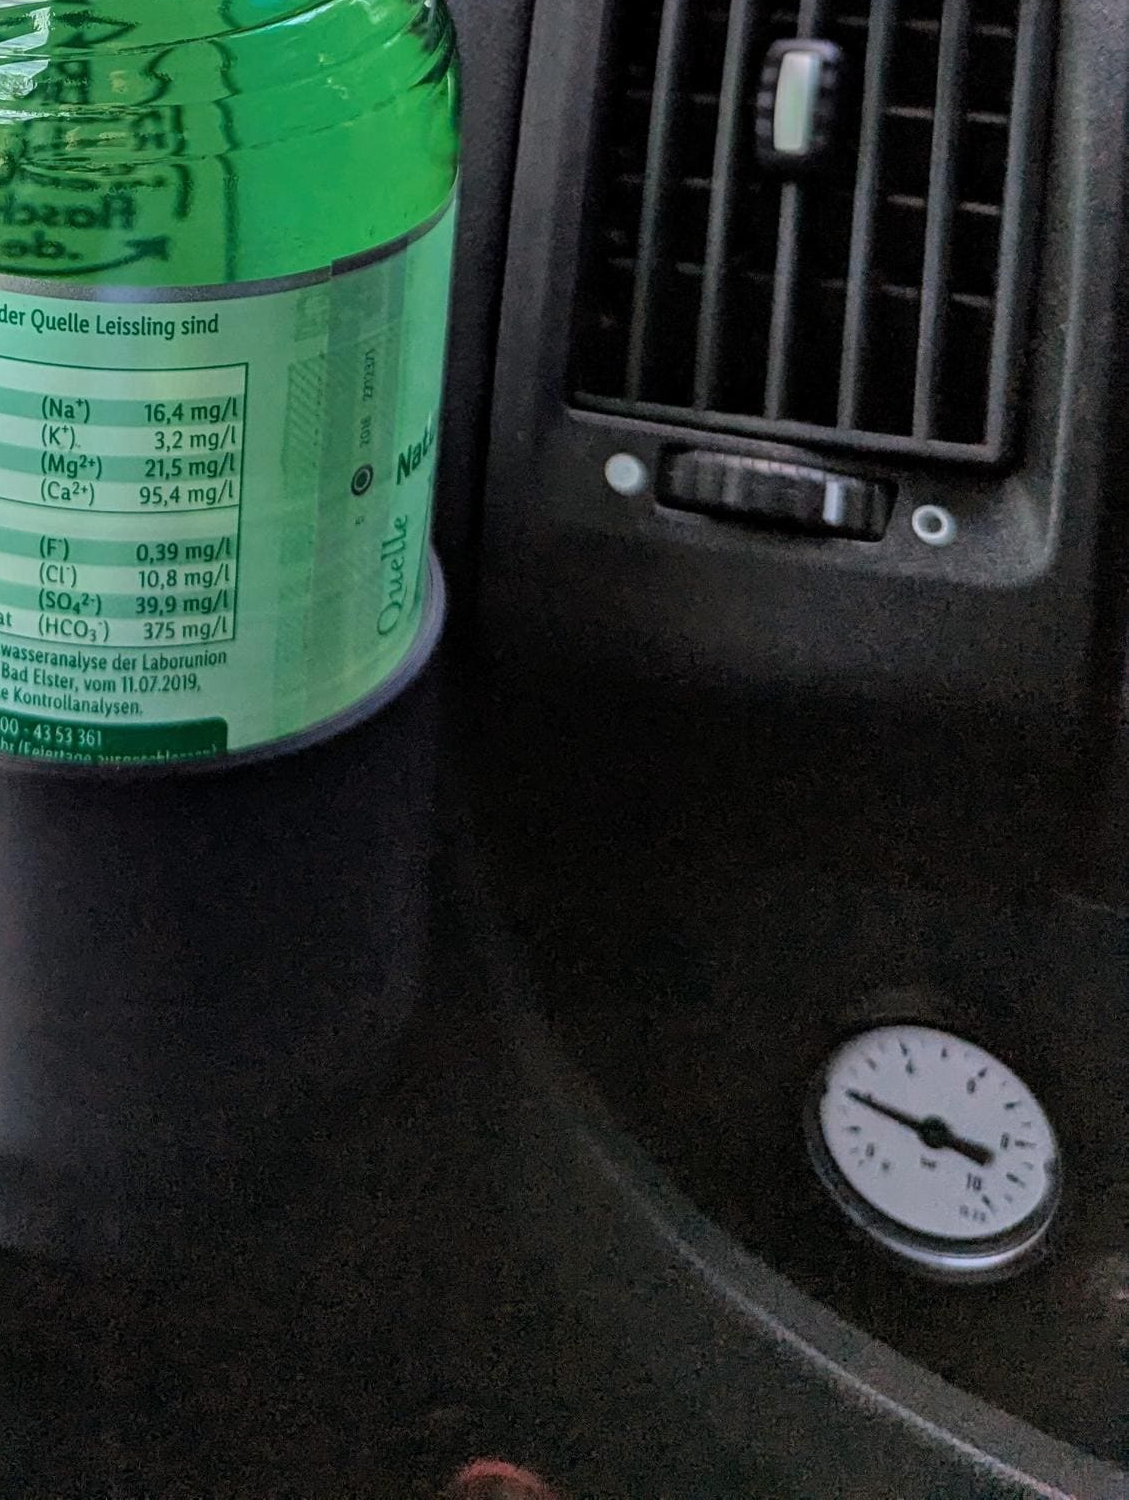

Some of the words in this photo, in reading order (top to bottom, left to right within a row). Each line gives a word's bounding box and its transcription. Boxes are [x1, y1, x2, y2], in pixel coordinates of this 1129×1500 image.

[30, 309, 90, 334] Quelle
[96, 315, 175, 340] Leissling
[181, 313, 219, 334] sind
[144, 402, 184, 425] 16,4
[190, 396, 238, 424] mg/l
[154, 429, 183, 452] 3,2
[189, 424, 236, 451] mg/l
[144, 457, 182, 480] 21,5
[188, 451, 235, 479] mg/l
[139, 485, 180, 507] 95,4
[187, 479, 233, 506] mg/l
[135, 542, 178, 564] 0,39
[185, 536, 231, 562] mg/l
[139, 569, 177, 590] 10,8
[184, 562, 229, 588] mg/l
[377, 513, 409, 636] Quelle
[135, 595, 177, 617] 39,9
[183, 588, 228, 615] mg/l
[143, 621, 175, 640] 375
[182, 615, 227, 641] mg/l
[111, 652, 137, 671] der
[142, 650, 228, 671] Laborunion
[1, 661, 28, 683] Bad
[33, 667, 79, 693] Elster,
[83, 678, 116, 693] vom
[13, 685, 144, 717] Kontrollanalysen.
[33, 723, 51, 743] 43
[55, 725, 72, 745] 53
[77, 727, 102, 747] 361
